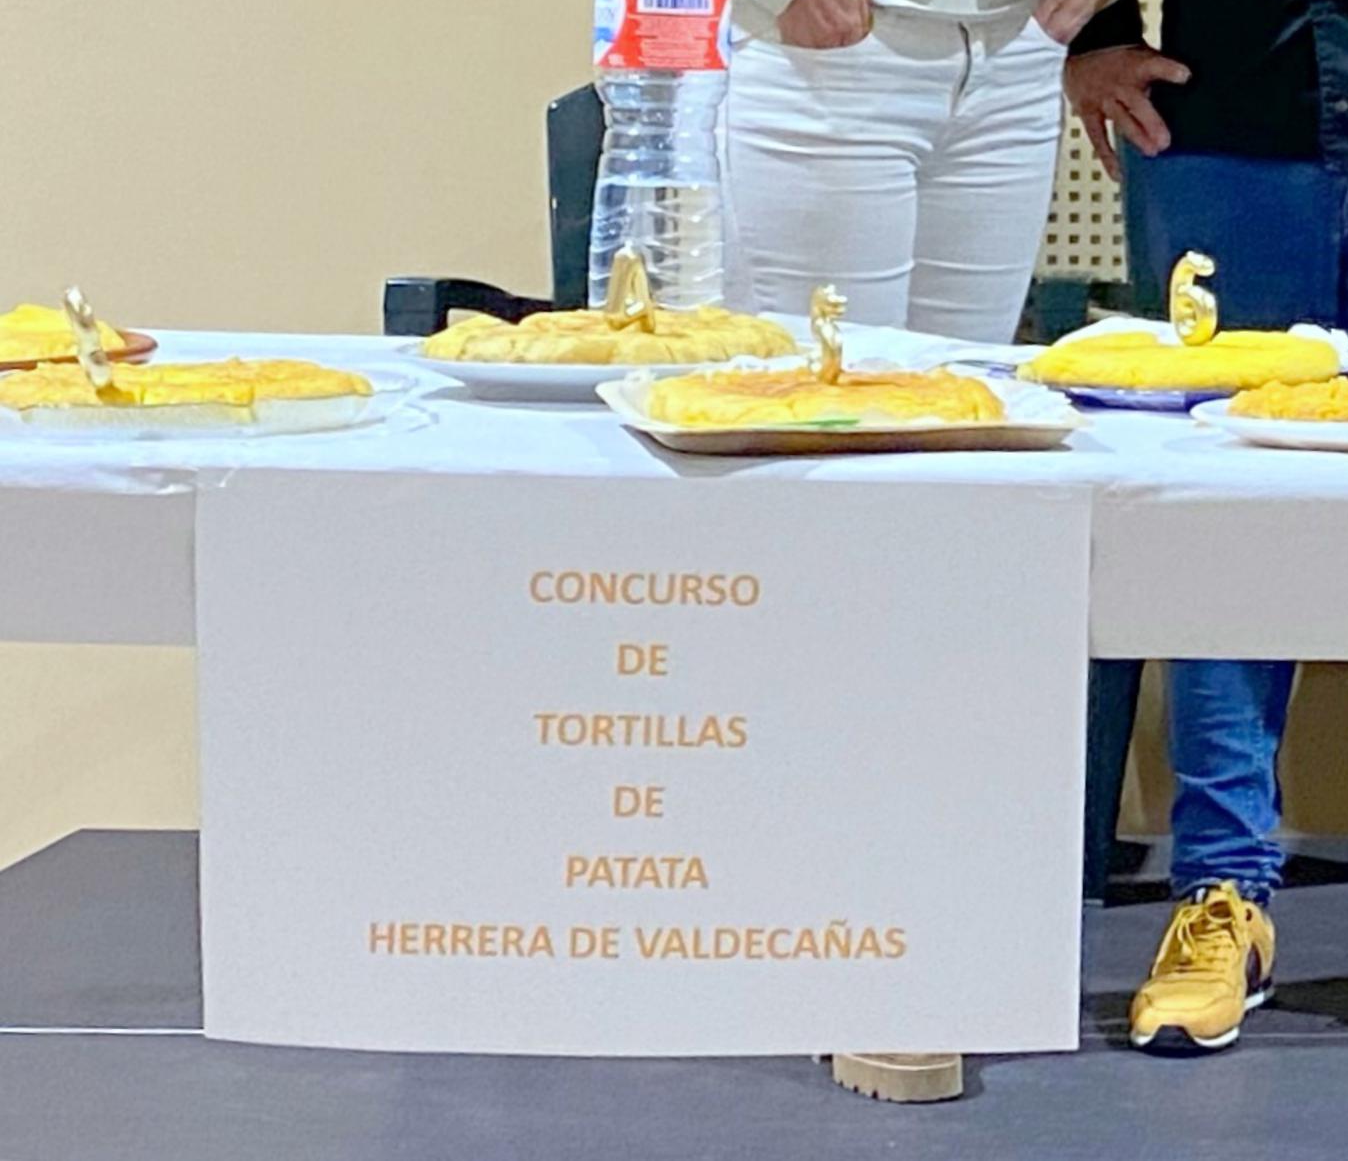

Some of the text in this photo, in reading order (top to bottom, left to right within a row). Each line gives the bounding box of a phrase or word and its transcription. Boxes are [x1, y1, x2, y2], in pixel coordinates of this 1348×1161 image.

[1169, 250, 1218, 347] 6
[529, 570, 762, 609] CONCURSO
[617, 643, 669, 678] DE
[534, 713, 750, 750] TORTILLAS
[613, 785, 666, 819] DE
[566, 855, 710, 891] PATATA
[369, 920, 908, 961] HERRERA DE VALDECAÑAS
